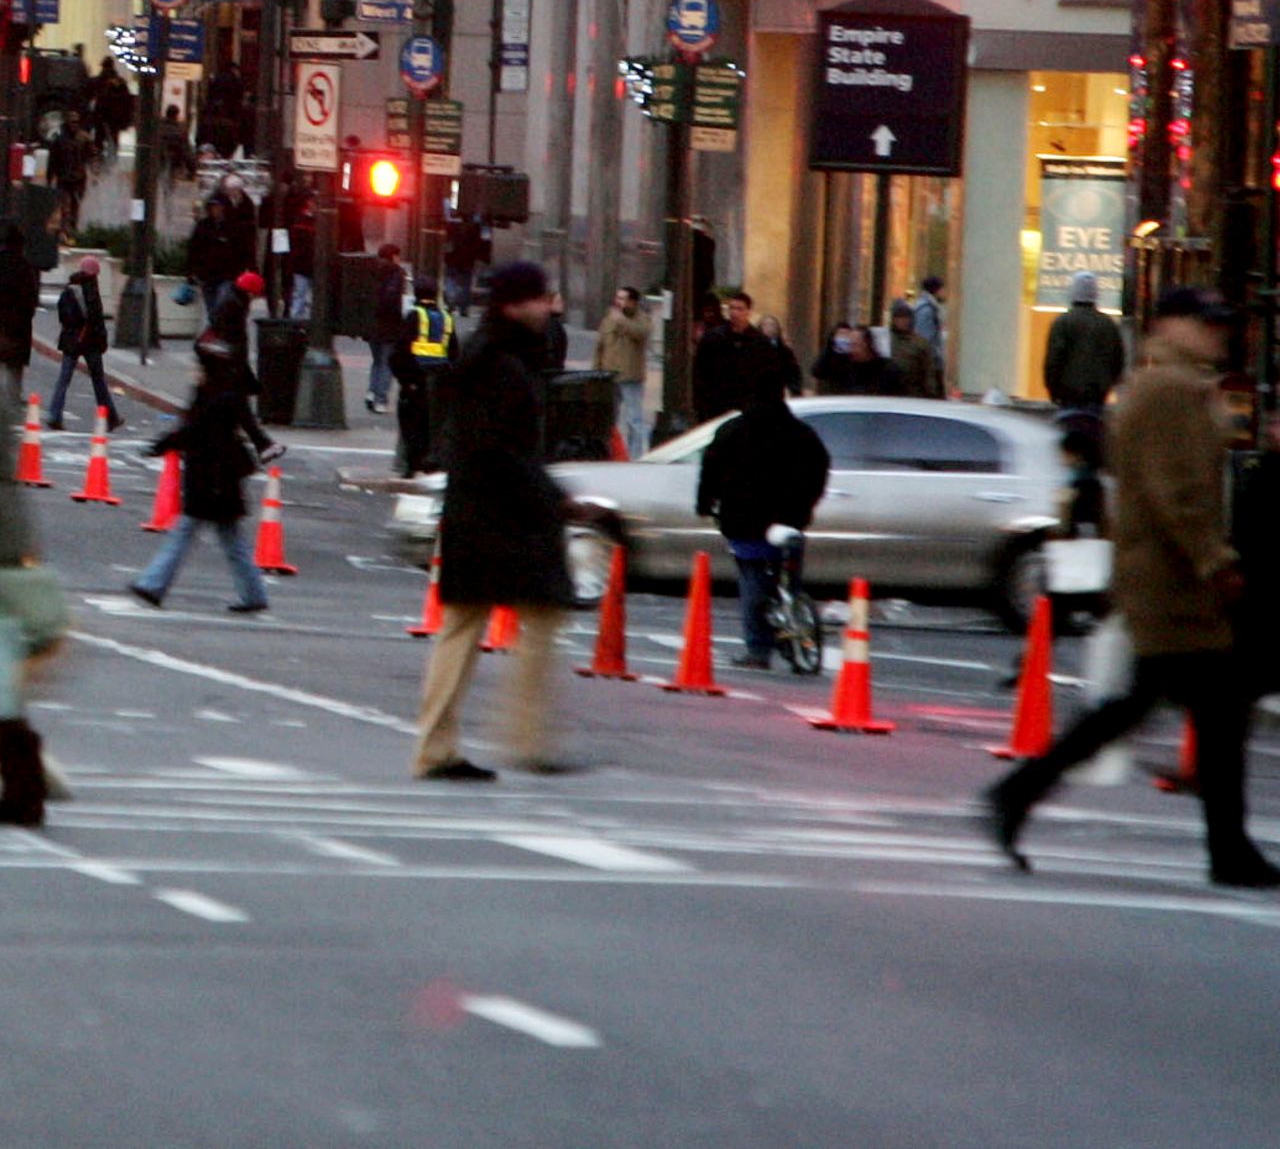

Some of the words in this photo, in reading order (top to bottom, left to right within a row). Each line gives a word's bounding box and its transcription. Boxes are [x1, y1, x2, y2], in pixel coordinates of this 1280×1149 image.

[828, 24, 905, 47] Empire
[828, 46, 887, 66] State
[826, 66, 914, 92] Building
[1058, 225, 1112, 249] EYE
[1042, 251, 1125, 274] EXAMS
